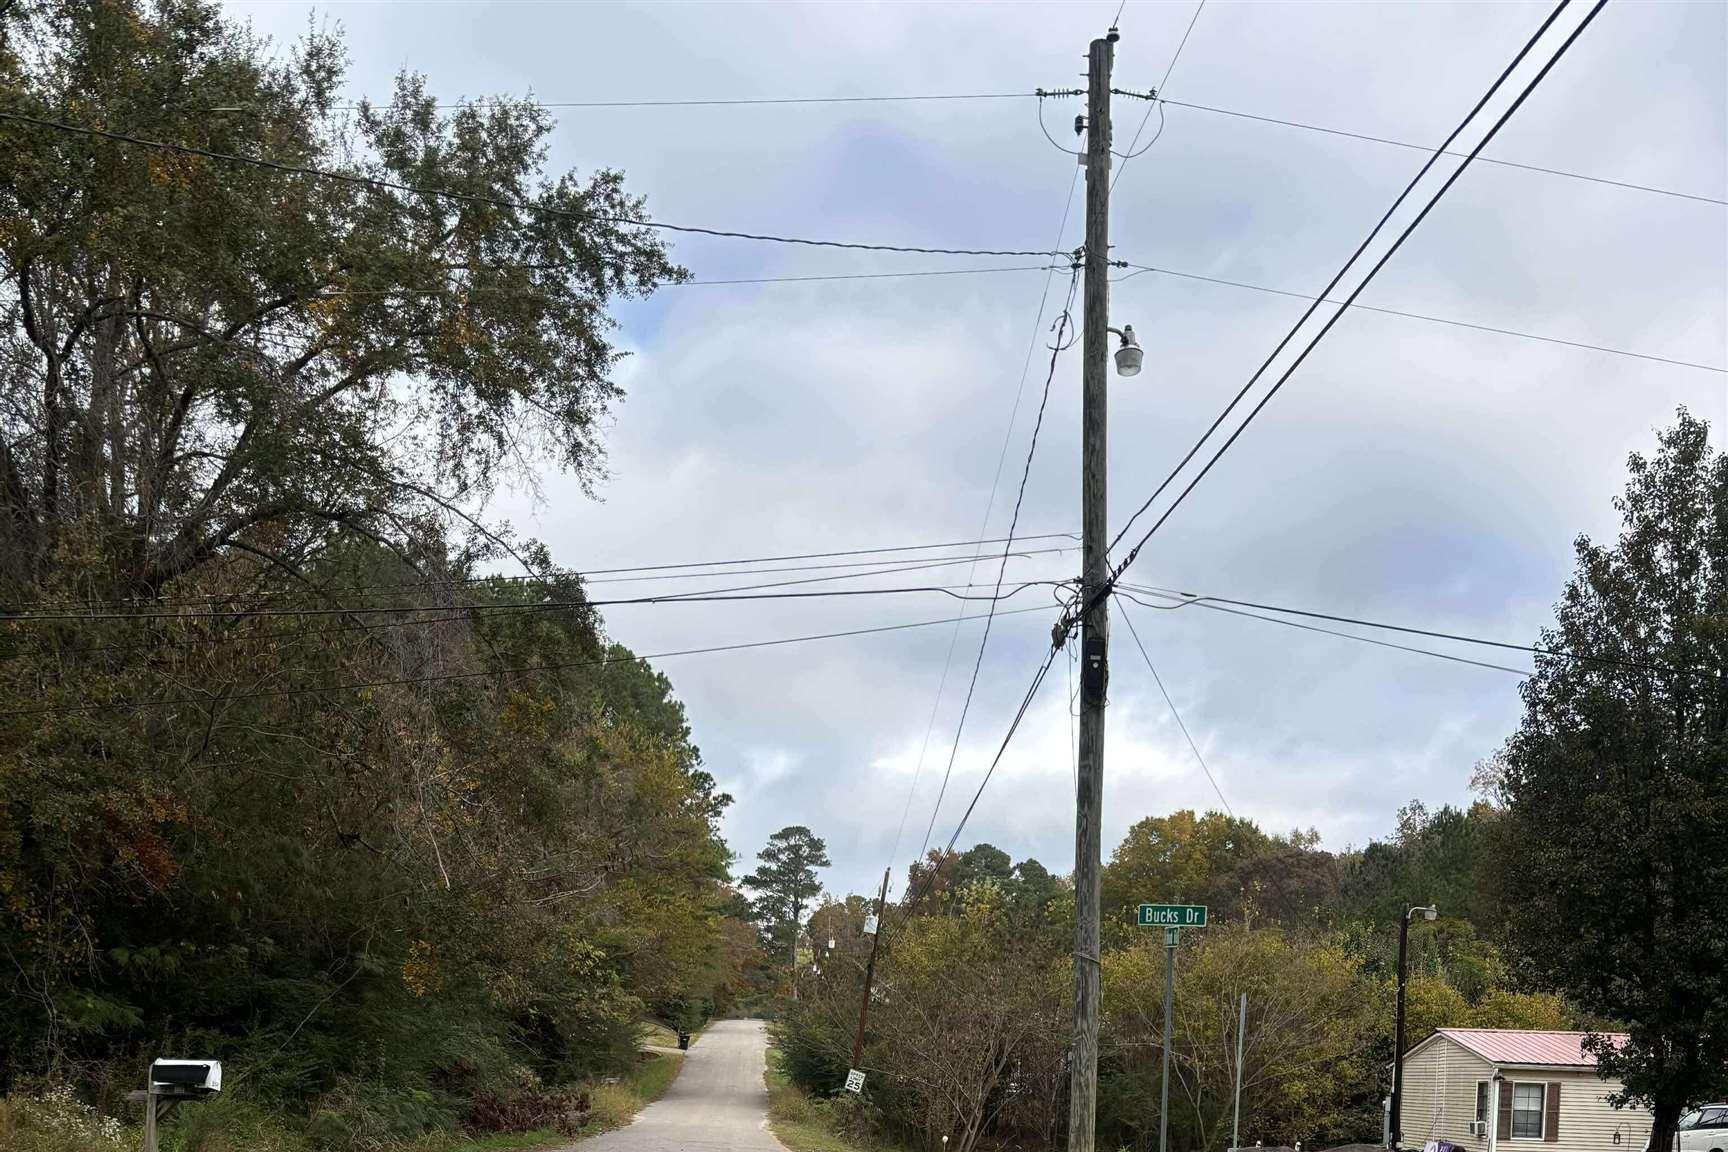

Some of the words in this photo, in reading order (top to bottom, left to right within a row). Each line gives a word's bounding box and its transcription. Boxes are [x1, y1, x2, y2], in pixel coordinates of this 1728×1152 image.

[1146, 908, 1179, 923] Bucks
[1186, 908, 1199, 923] Dr
[847, 1080, 861, 1090] 25
